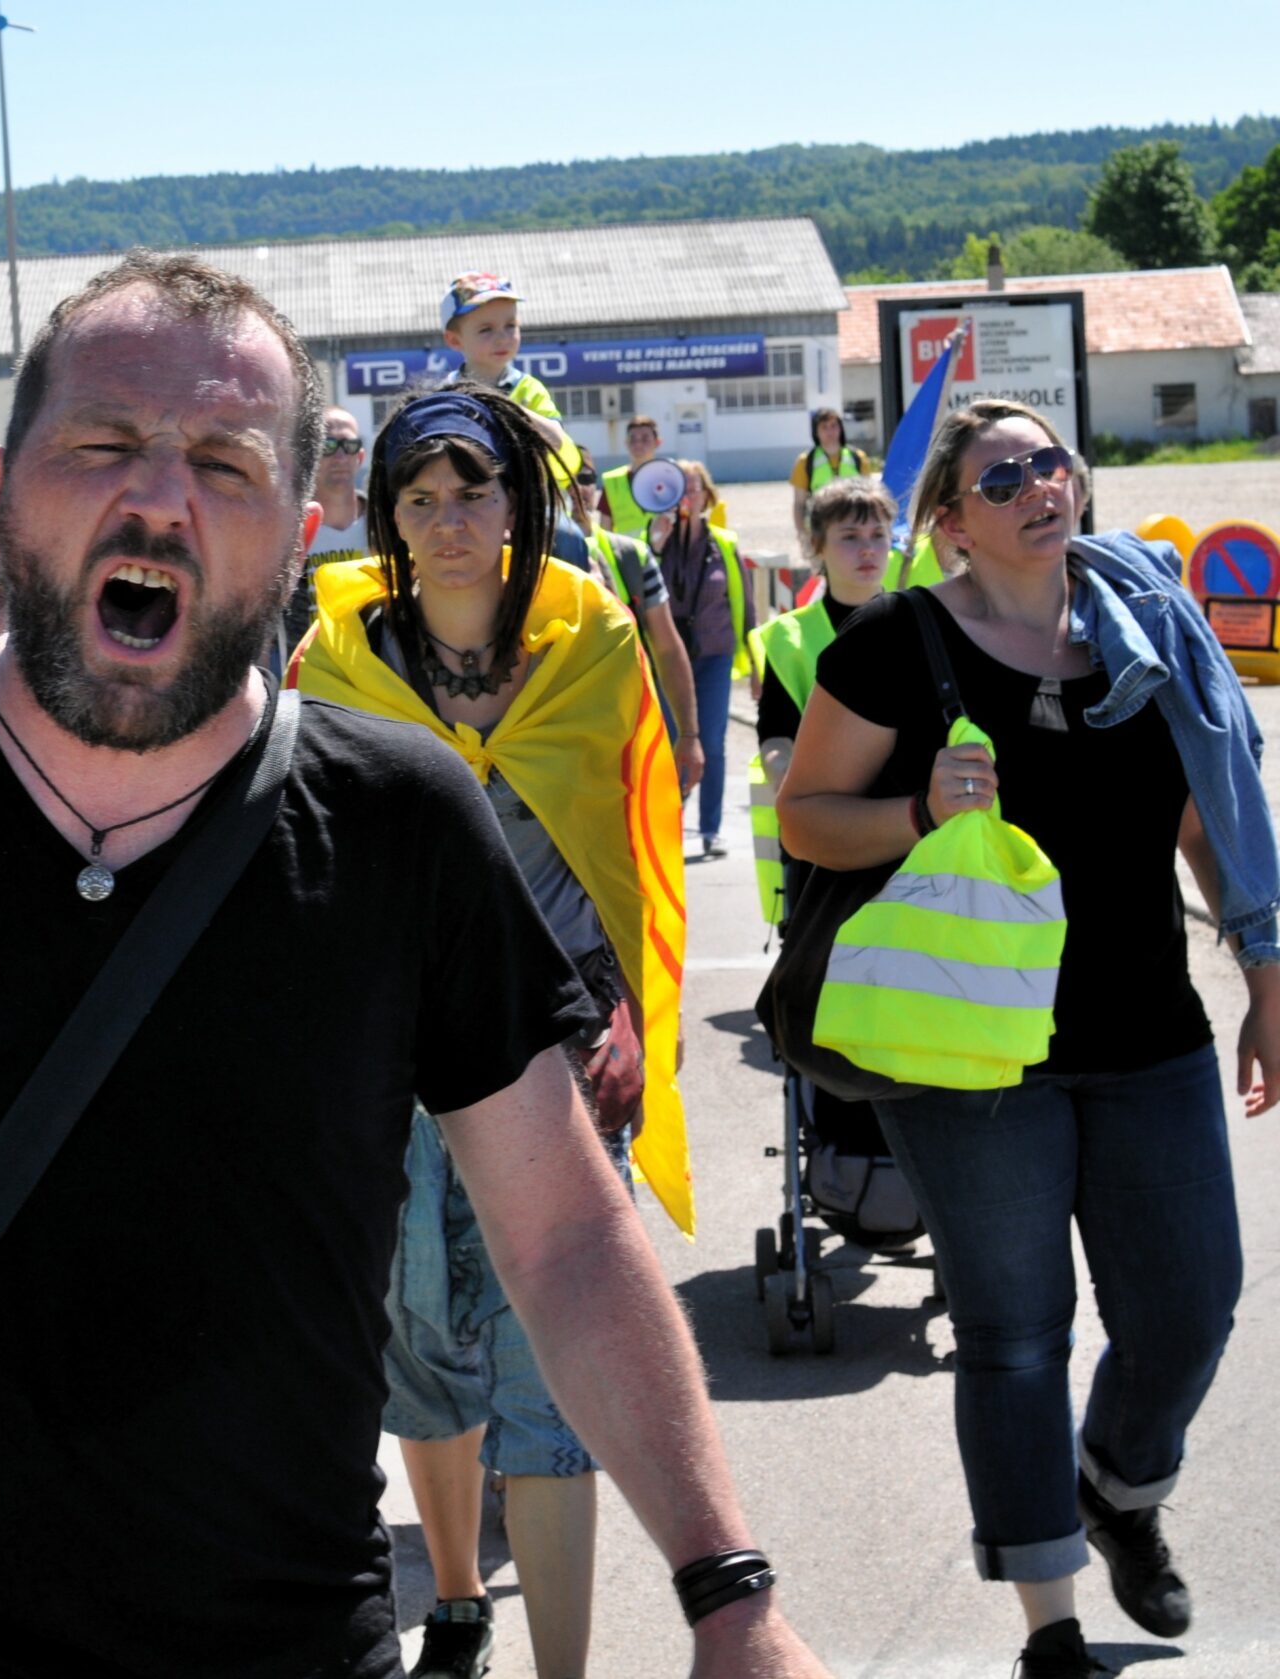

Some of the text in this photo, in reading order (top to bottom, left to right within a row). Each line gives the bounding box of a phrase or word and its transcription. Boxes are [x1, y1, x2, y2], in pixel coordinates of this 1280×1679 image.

[582, 350, 622, 362] VENTE
[624, 348, 642, 360] DE
[352, 359, 406, 387] TB
[617, 357, 727, 373] TOUTES MARQUES
